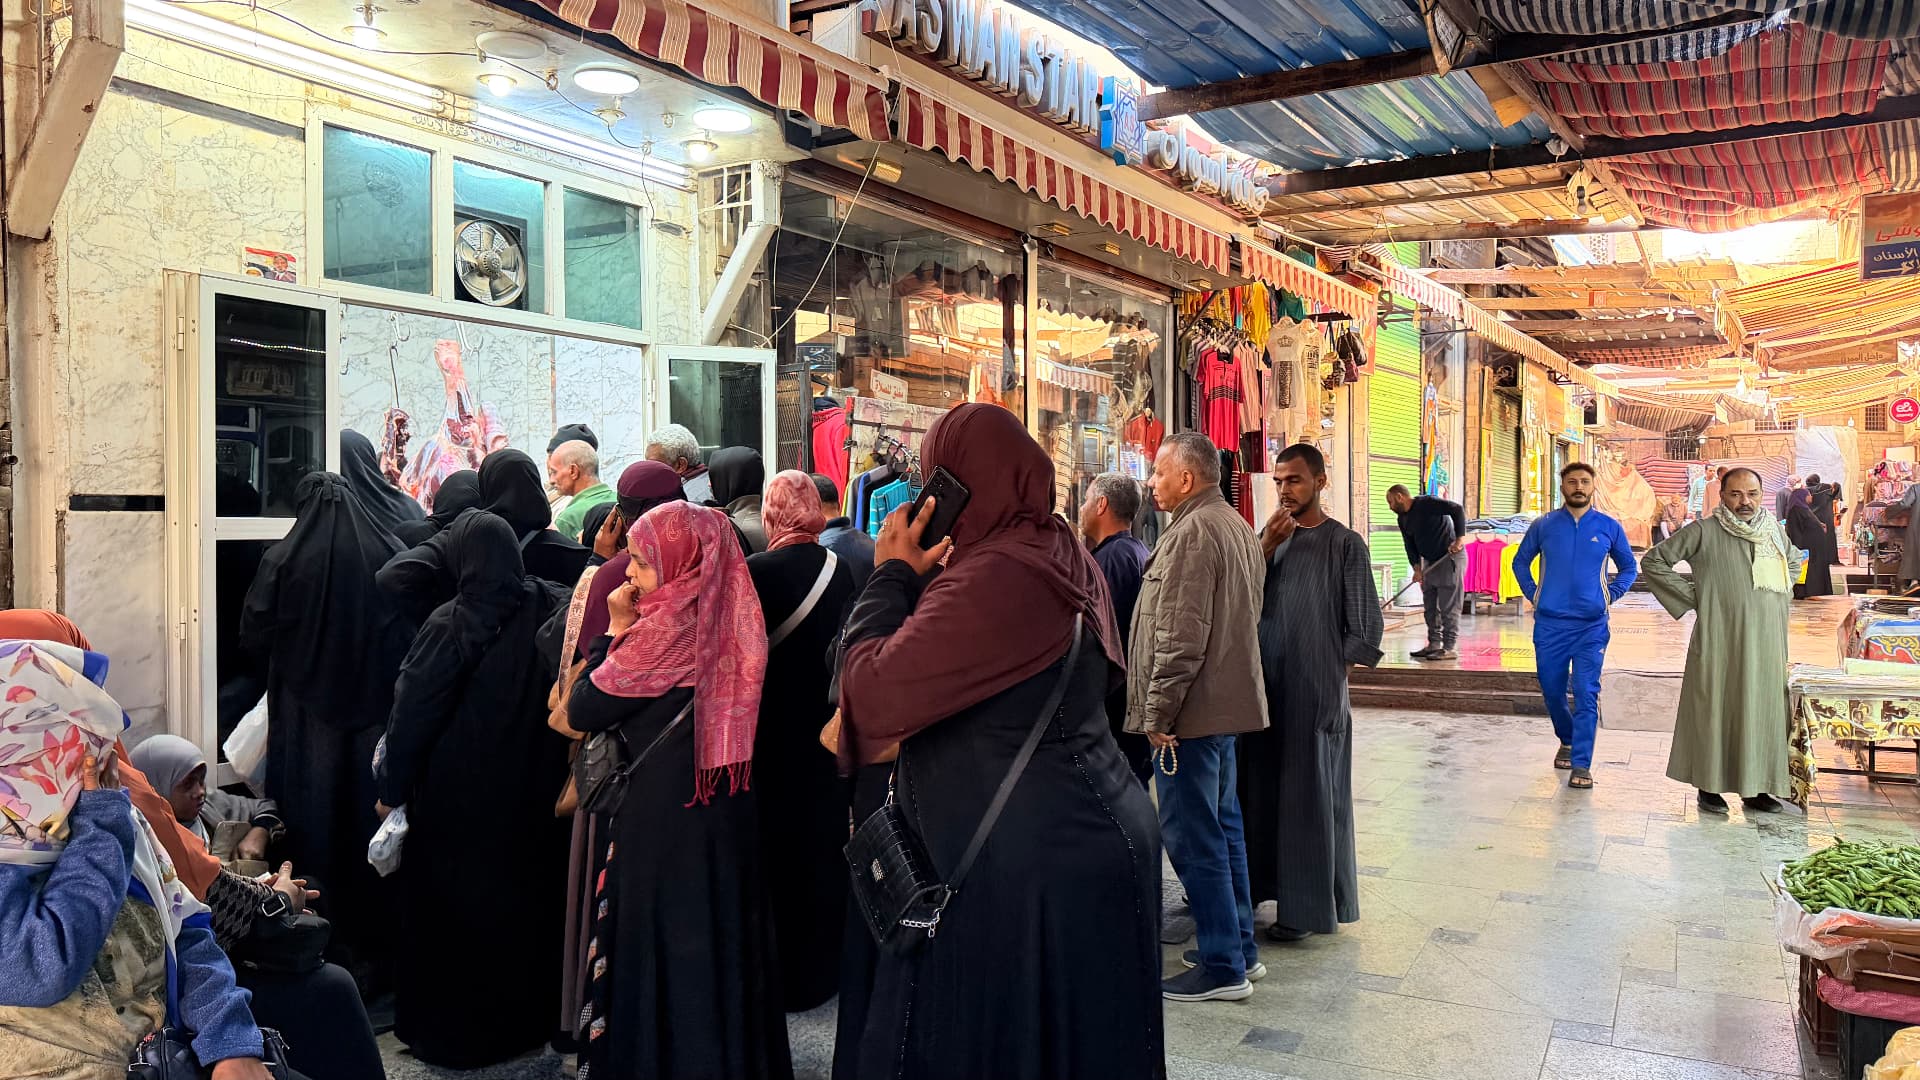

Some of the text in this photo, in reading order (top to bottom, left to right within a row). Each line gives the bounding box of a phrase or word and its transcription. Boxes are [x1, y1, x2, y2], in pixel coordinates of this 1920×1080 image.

[1021, 28, 1099, 137] STAR
[1123, 112, 1135, 134] AS
[1873, 246, 1918, 263] الأسنان
